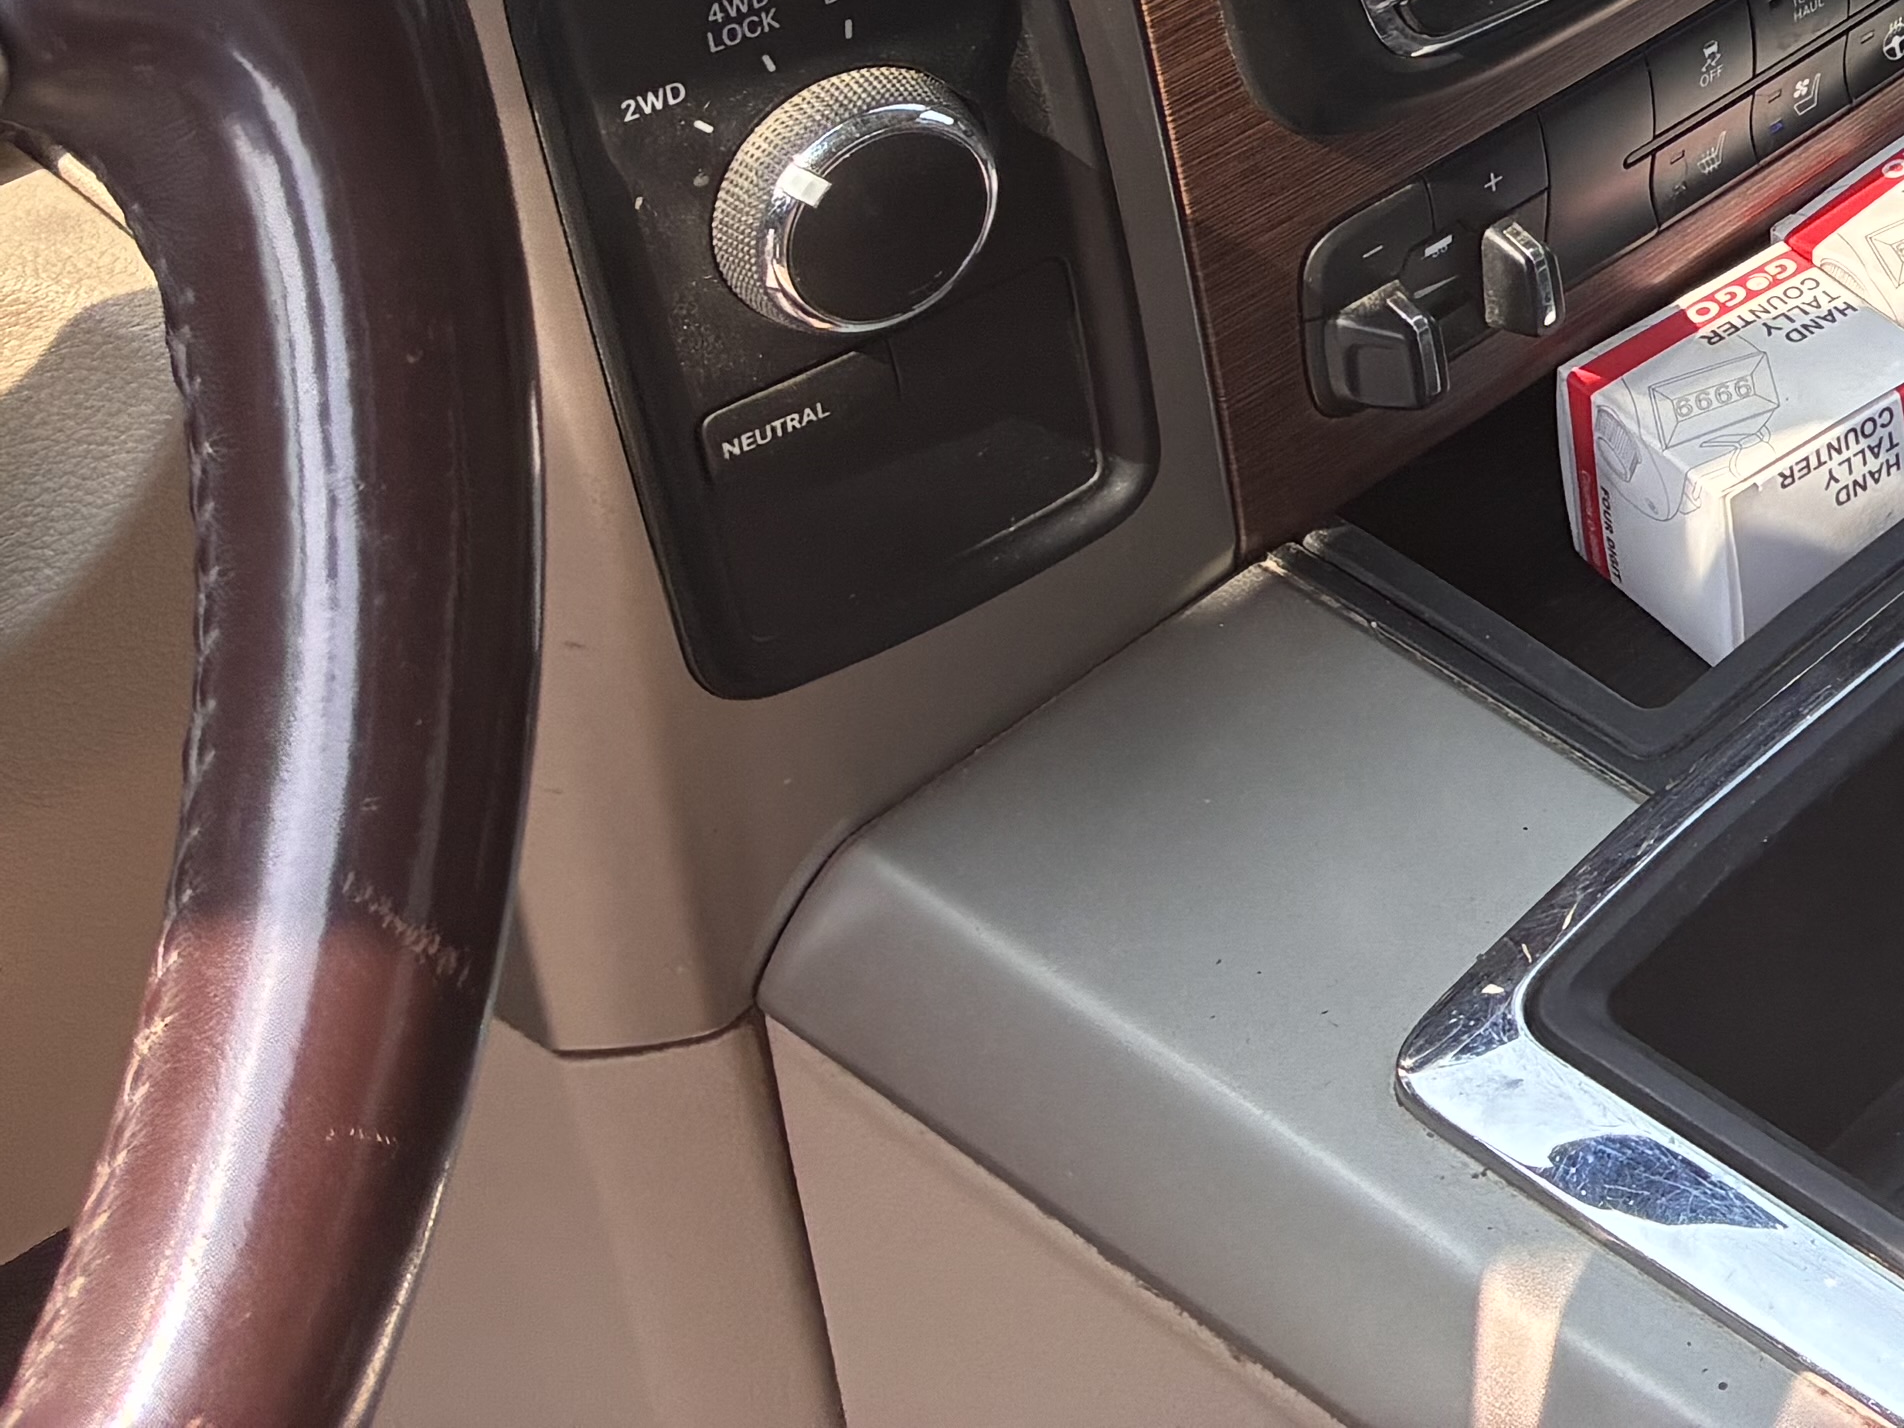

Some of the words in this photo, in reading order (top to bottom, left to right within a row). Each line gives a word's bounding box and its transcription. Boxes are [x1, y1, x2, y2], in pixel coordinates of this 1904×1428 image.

[706, 8, 781, 53] LOCK
[1793, 0, 1825, 23] HAUL
[1699, 64, 1724, 88] OFF
[619, 80, 688, 124] 2WD
[1685, 258, 1798, 324] GOGO
[1700, 277, 1821, 346] COUNTER
[1761, 290, 1841, 337] TALLY
[1785, 301, 1859, 343] HAND
[721, 401, 831, 460] NEUTRAL
[1777, 405, 1895, 490] COUNTER
[1825, 430, 1900, 491] TALLY
[1834, 452, 1901, 507] HAND
[1600, 485, 1614, 535] FOUR
[1606, 535, 1623, 584] DIGIT
